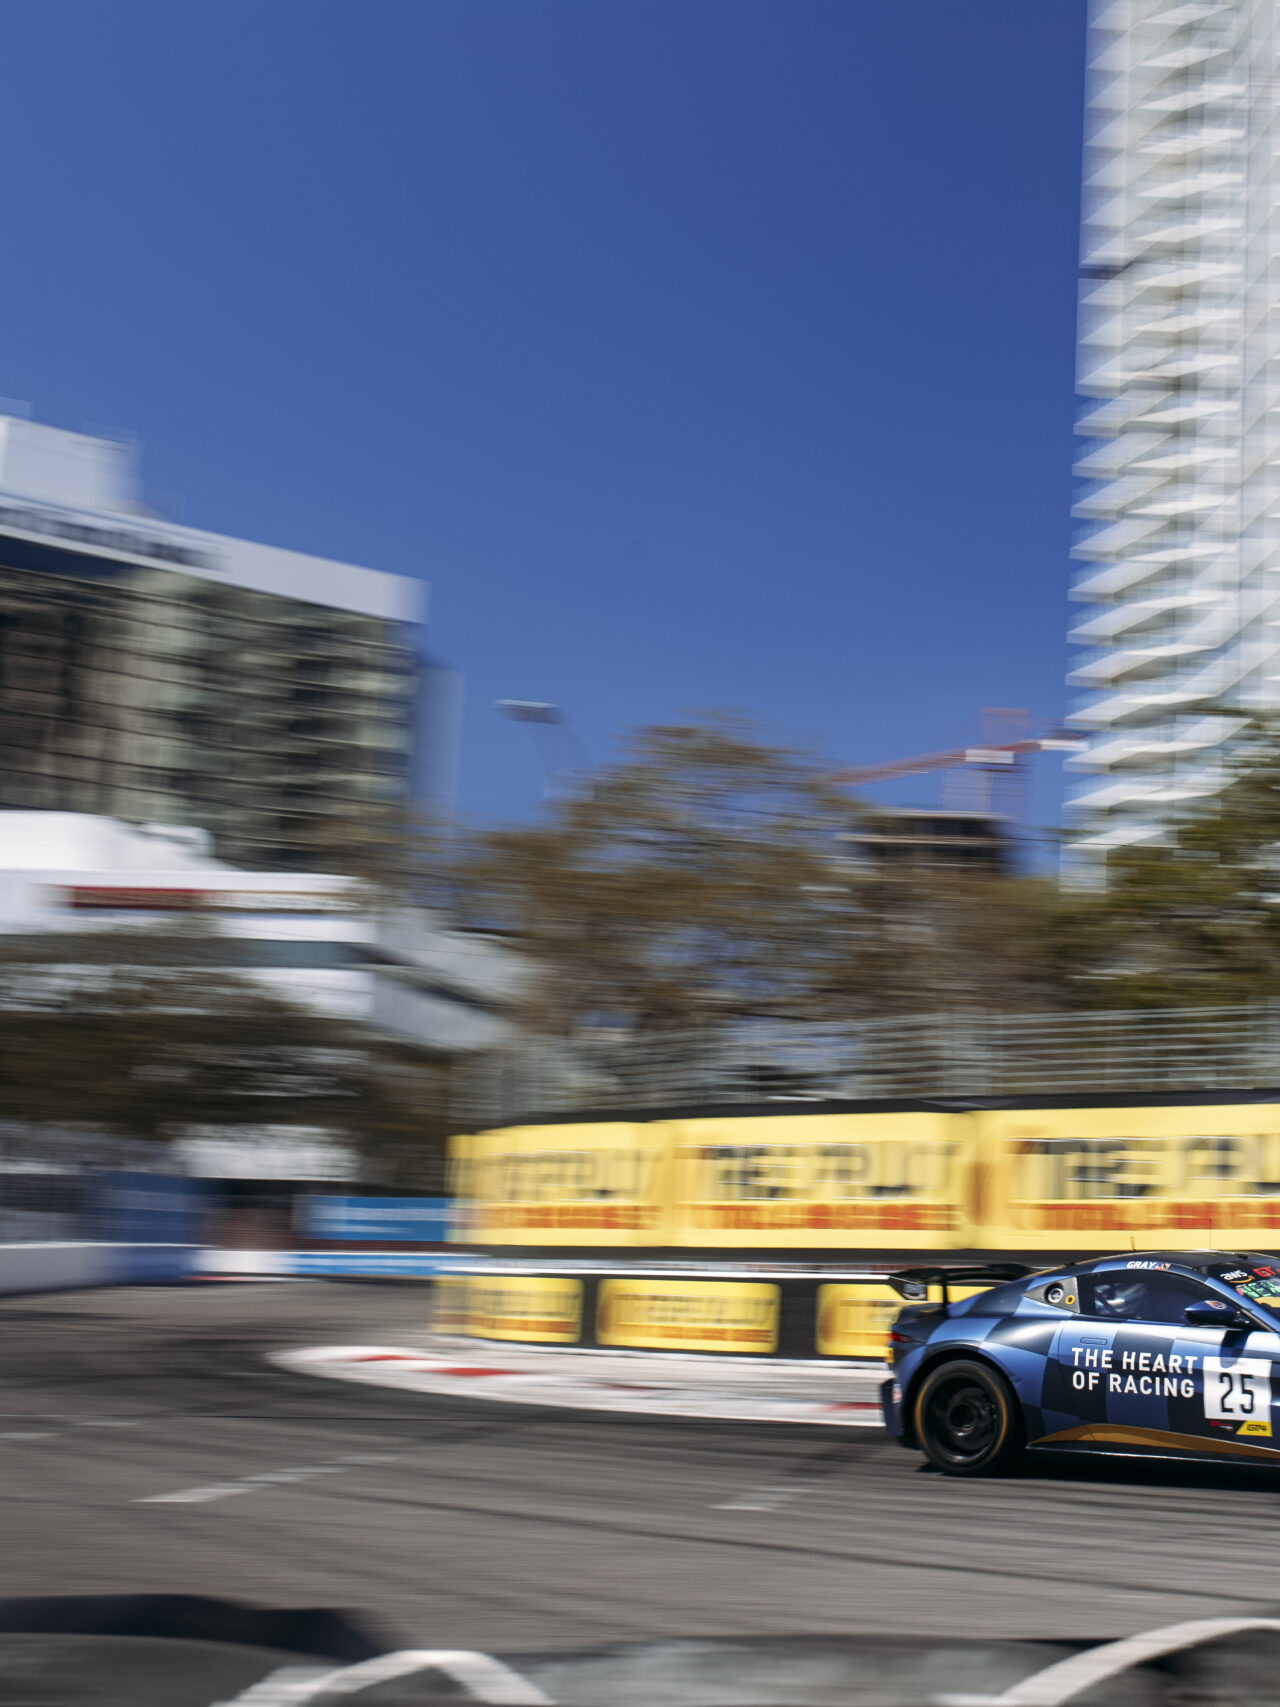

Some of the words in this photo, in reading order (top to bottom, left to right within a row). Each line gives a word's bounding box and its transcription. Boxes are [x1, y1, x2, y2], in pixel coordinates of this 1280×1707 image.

[1126, 1261, 1157, 1270] GRAY
[1071, 1347, 1114, 1369] THE
[1122, 1351, 1198, 1375] HEART
[1072, 1370, 1100, 1391] OF
[1109, 1373, 1195, 1398] RACING
[1219, 1372, 1255, 1414] 25
